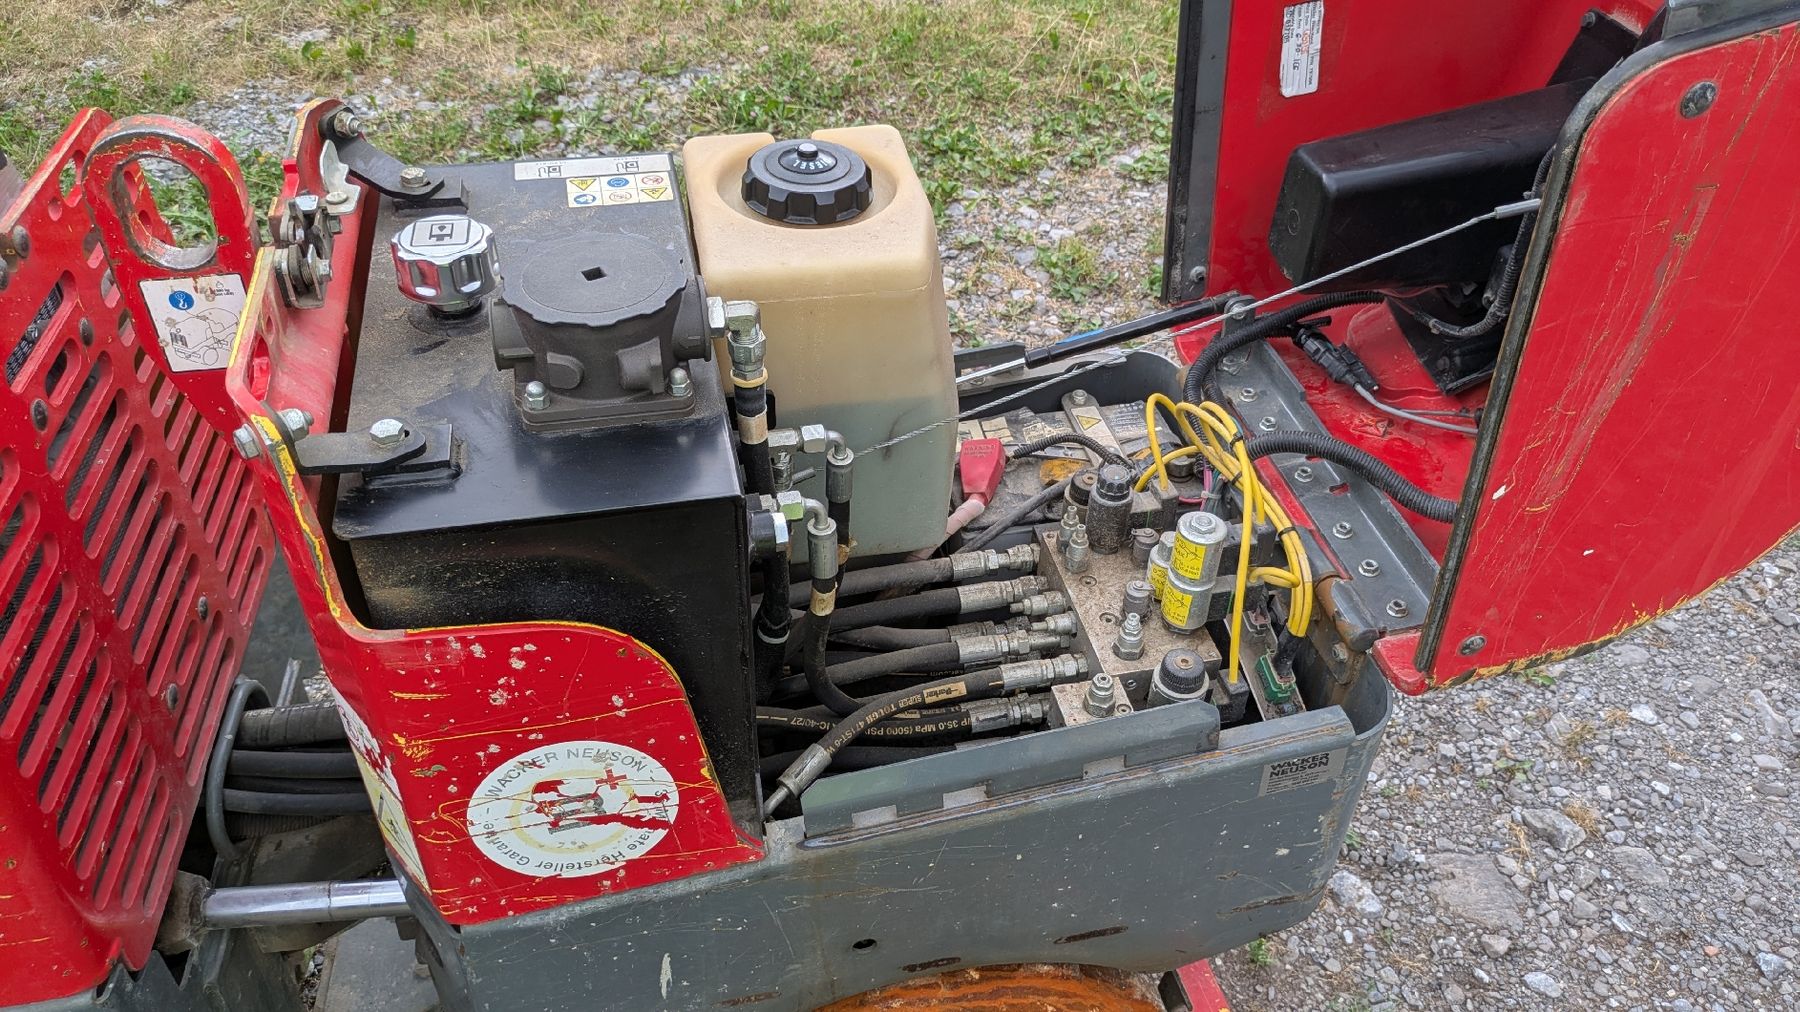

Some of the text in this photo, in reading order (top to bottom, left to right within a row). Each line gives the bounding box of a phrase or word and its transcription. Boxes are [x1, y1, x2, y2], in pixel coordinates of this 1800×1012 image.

[793, 158, 832, 170] DIESEL
[898, 694, 923, 708] SUPER
[926, 688, 953, 700] Parker
[865, 704, 896, 723] TOUGH
[915, 724, 936, 733] MPa
[938, 720, 958, 730] 35.0
[1270, 760, 1330, 778] NEUSON
[1271, 753, 1330, 771] WACKER
[485, 747, 649, 798] WACKER NEUSON
[534, 850, 630, 873] Hersteller
